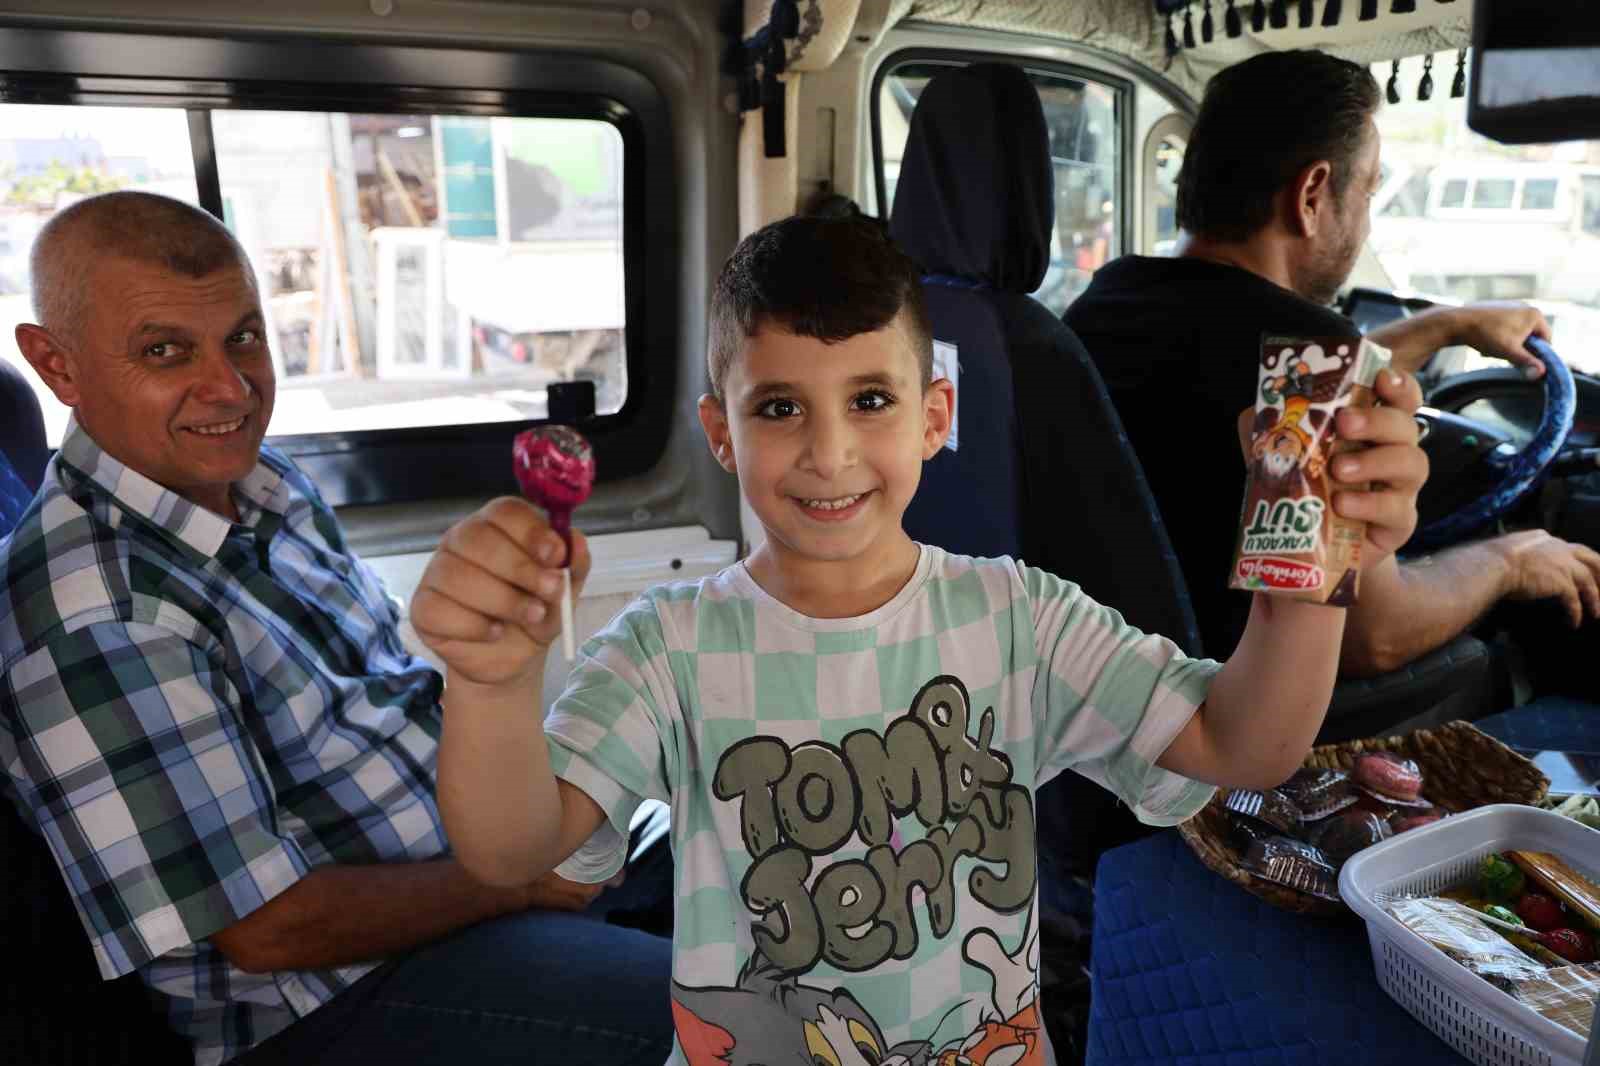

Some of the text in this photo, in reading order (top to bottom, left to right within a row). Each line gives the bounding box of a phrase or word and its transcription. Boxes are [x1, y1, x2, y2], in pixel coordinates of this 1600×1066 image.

[1246, 499, 1322, 535] SÜT
[1245, 536, 1312, 551] KAKAOLU
[740, 784, 1038, 977] Jerry
